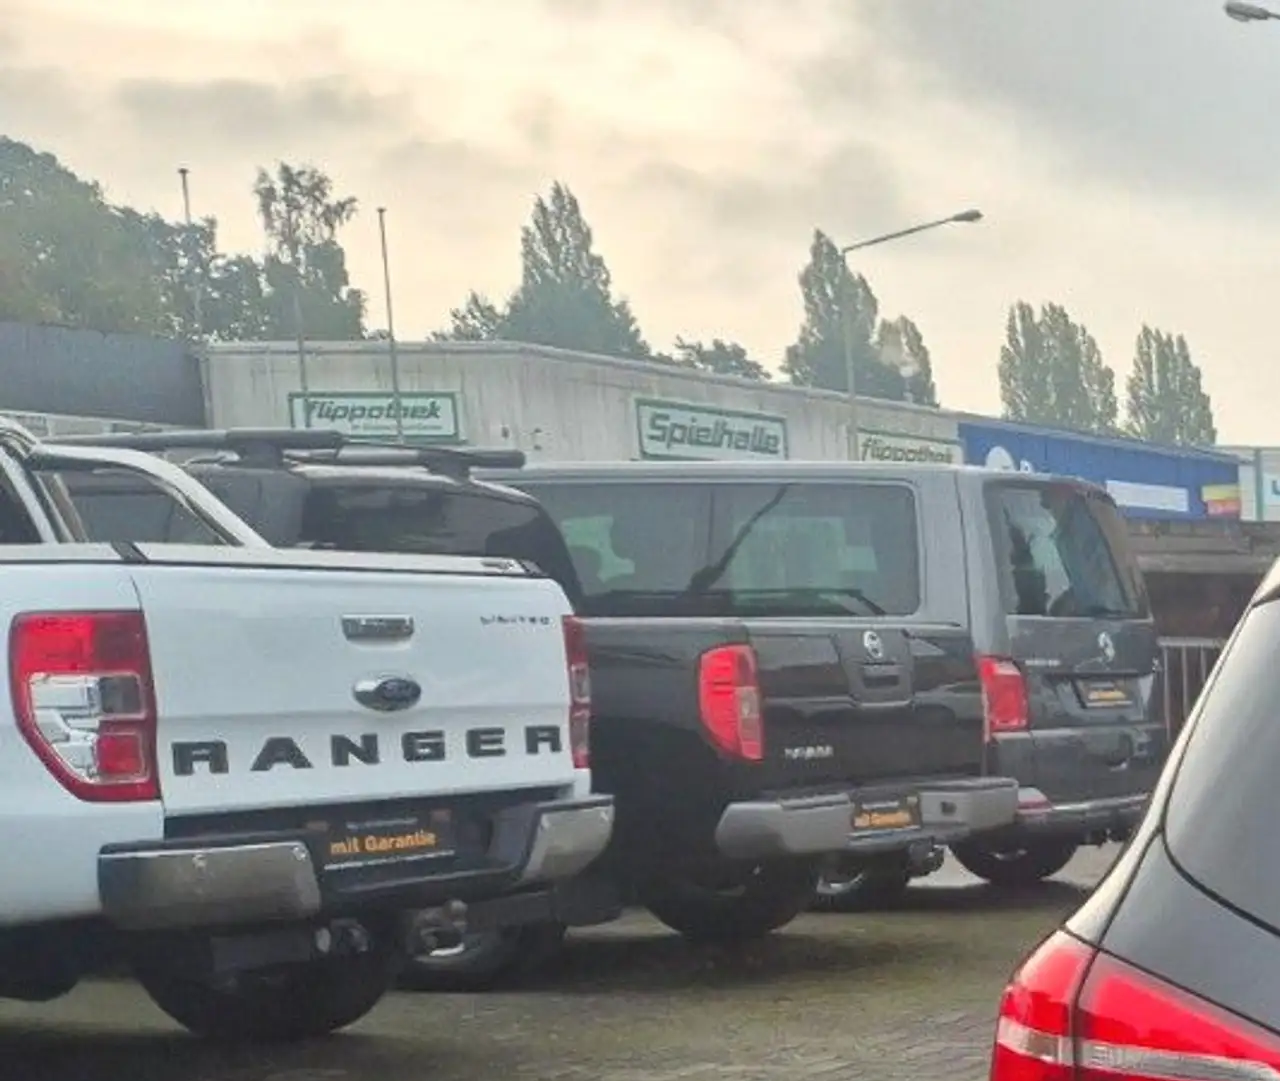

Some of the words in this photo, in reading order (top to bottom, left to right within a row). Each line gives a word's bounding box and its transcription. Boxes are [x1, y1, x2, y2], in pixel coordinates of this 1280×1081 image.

[648, 412, 781, 454] Spielhalle
[172, 724, 563, 776] RANGER
[330, 836, 360, 855] mit
[364, 828, 437, 851] Garantie
